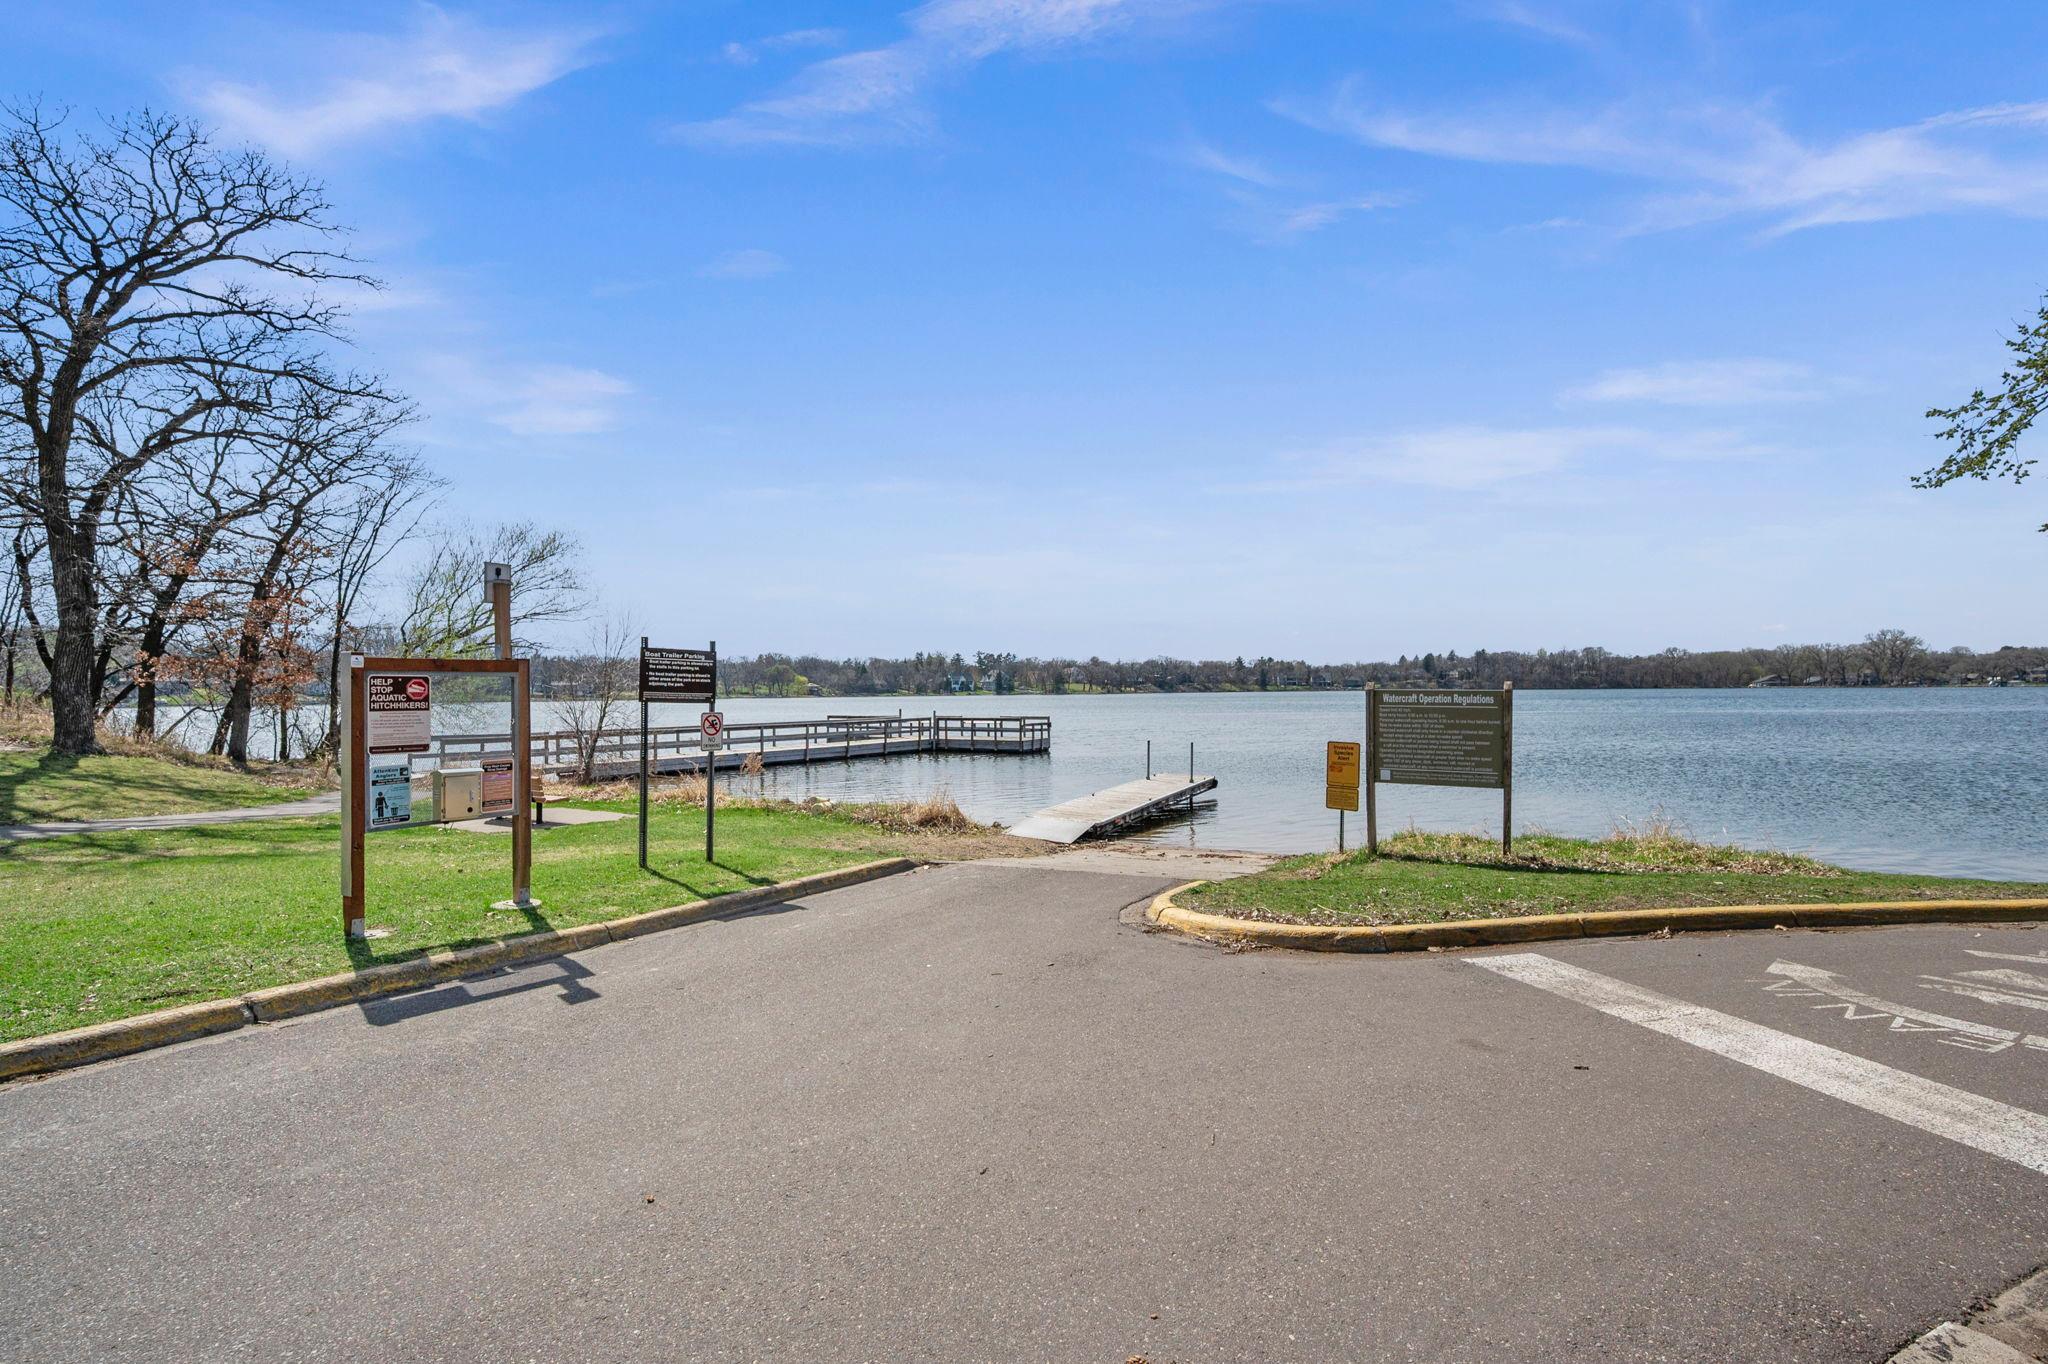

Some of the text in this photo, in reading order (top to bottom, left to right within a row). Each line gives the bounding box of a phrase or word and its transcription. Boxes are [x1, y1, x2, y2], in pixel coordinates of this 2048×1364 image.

[370, 686, 393, 694] STOP
[370, 694, 407, 702] AQUATIC
[1382, 693, 1495, 706] Watercraft Operation Regulations
[370, 702, 429, 710] HITCHHIKERS!
